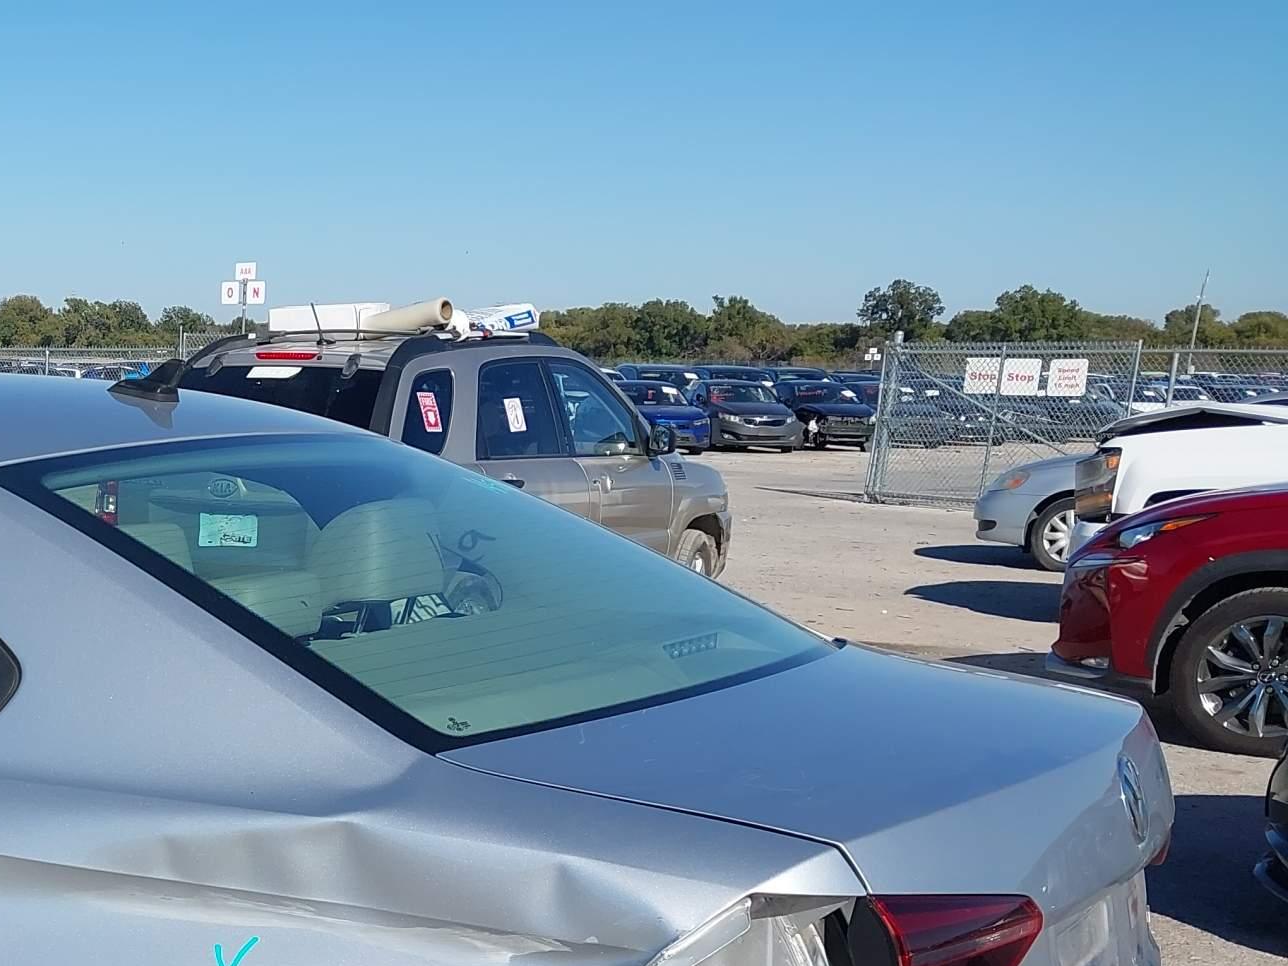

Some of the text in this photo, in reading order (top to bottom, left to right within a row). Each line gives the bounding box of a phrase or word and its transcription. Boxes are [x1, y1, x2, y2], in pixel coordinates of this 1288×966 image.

[252, 287, 260, 299] N
[969, 371, 997, 384] Stop
[1007, 372, 1035, 384] Stop
